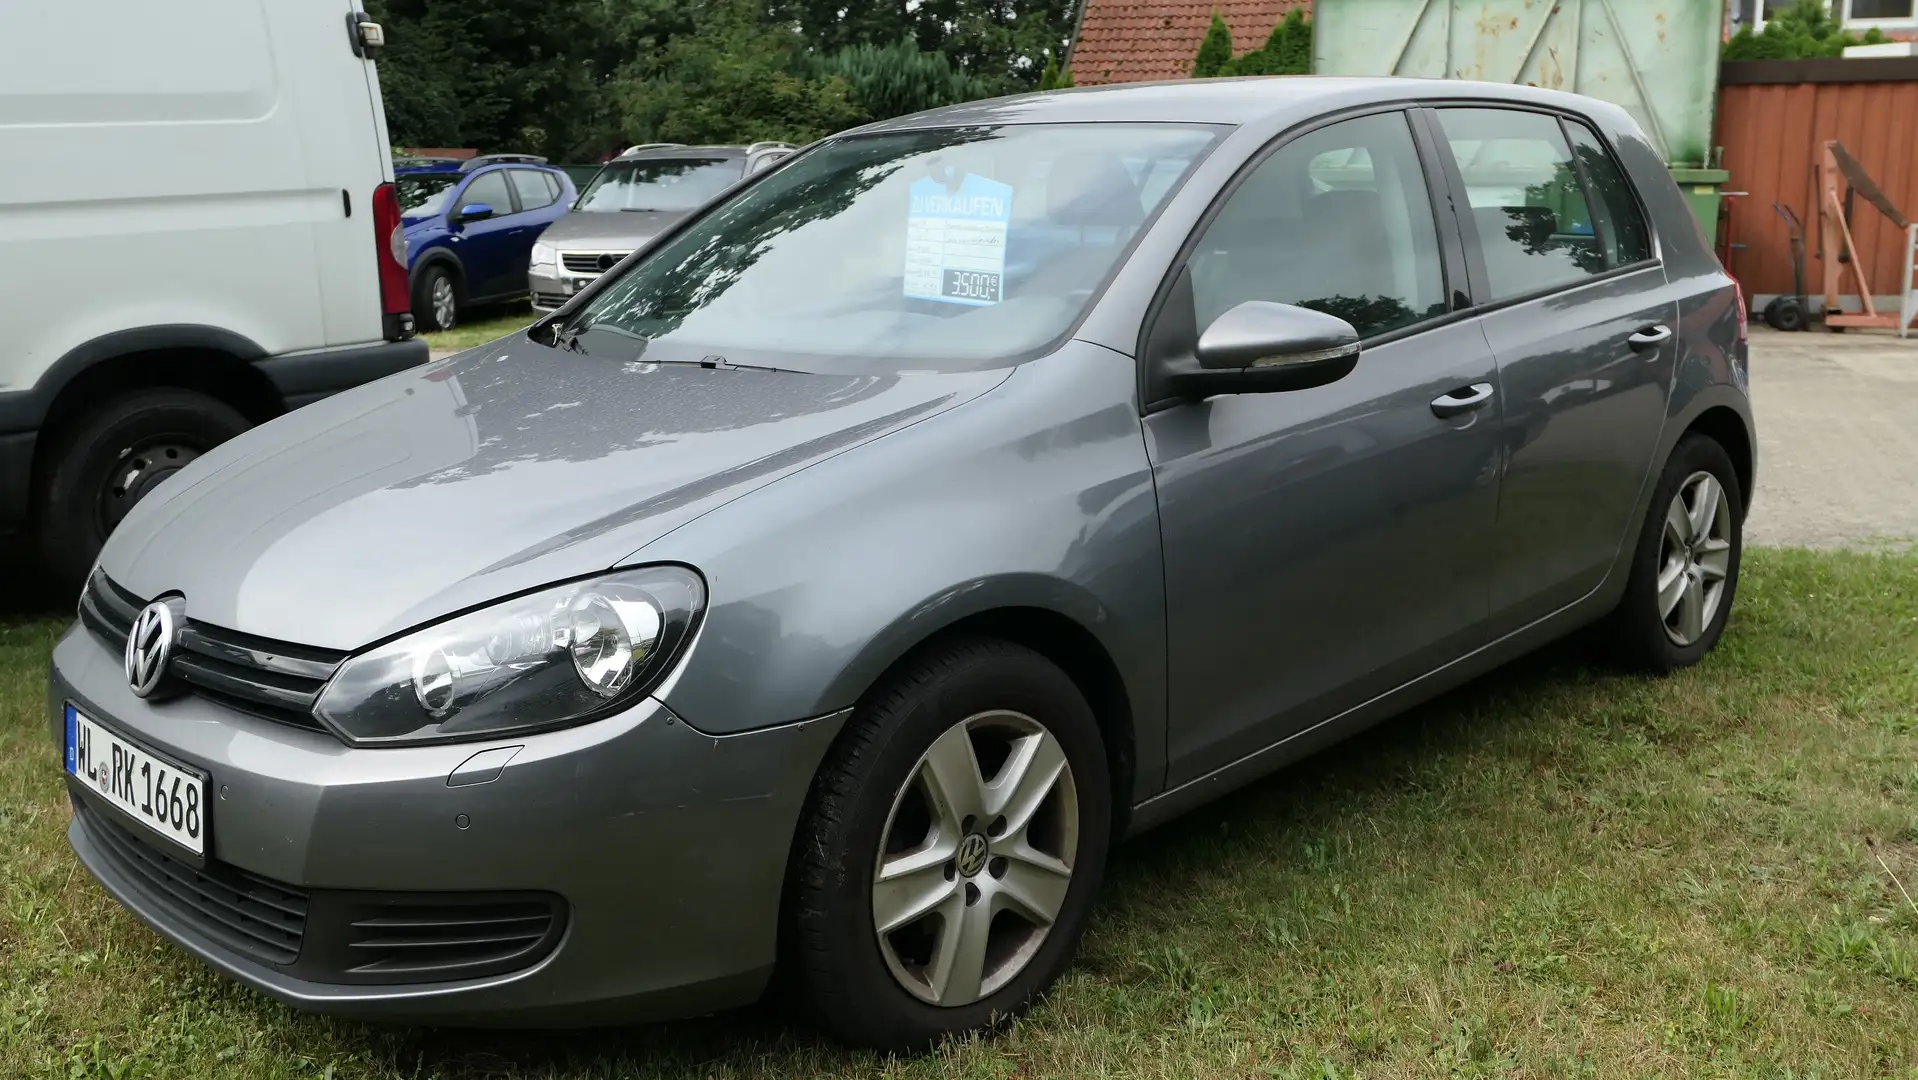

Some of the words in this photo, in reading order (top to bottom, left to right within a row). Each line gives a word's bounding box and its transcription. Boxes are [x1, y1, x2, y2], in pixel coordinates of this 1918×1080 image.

[925, 195, 1004, 218] VERKAUFEN
[77, 720, 97, 782] WL
[112, 742, 136, 807] RK
[141, 761, 200, 839] 1668
